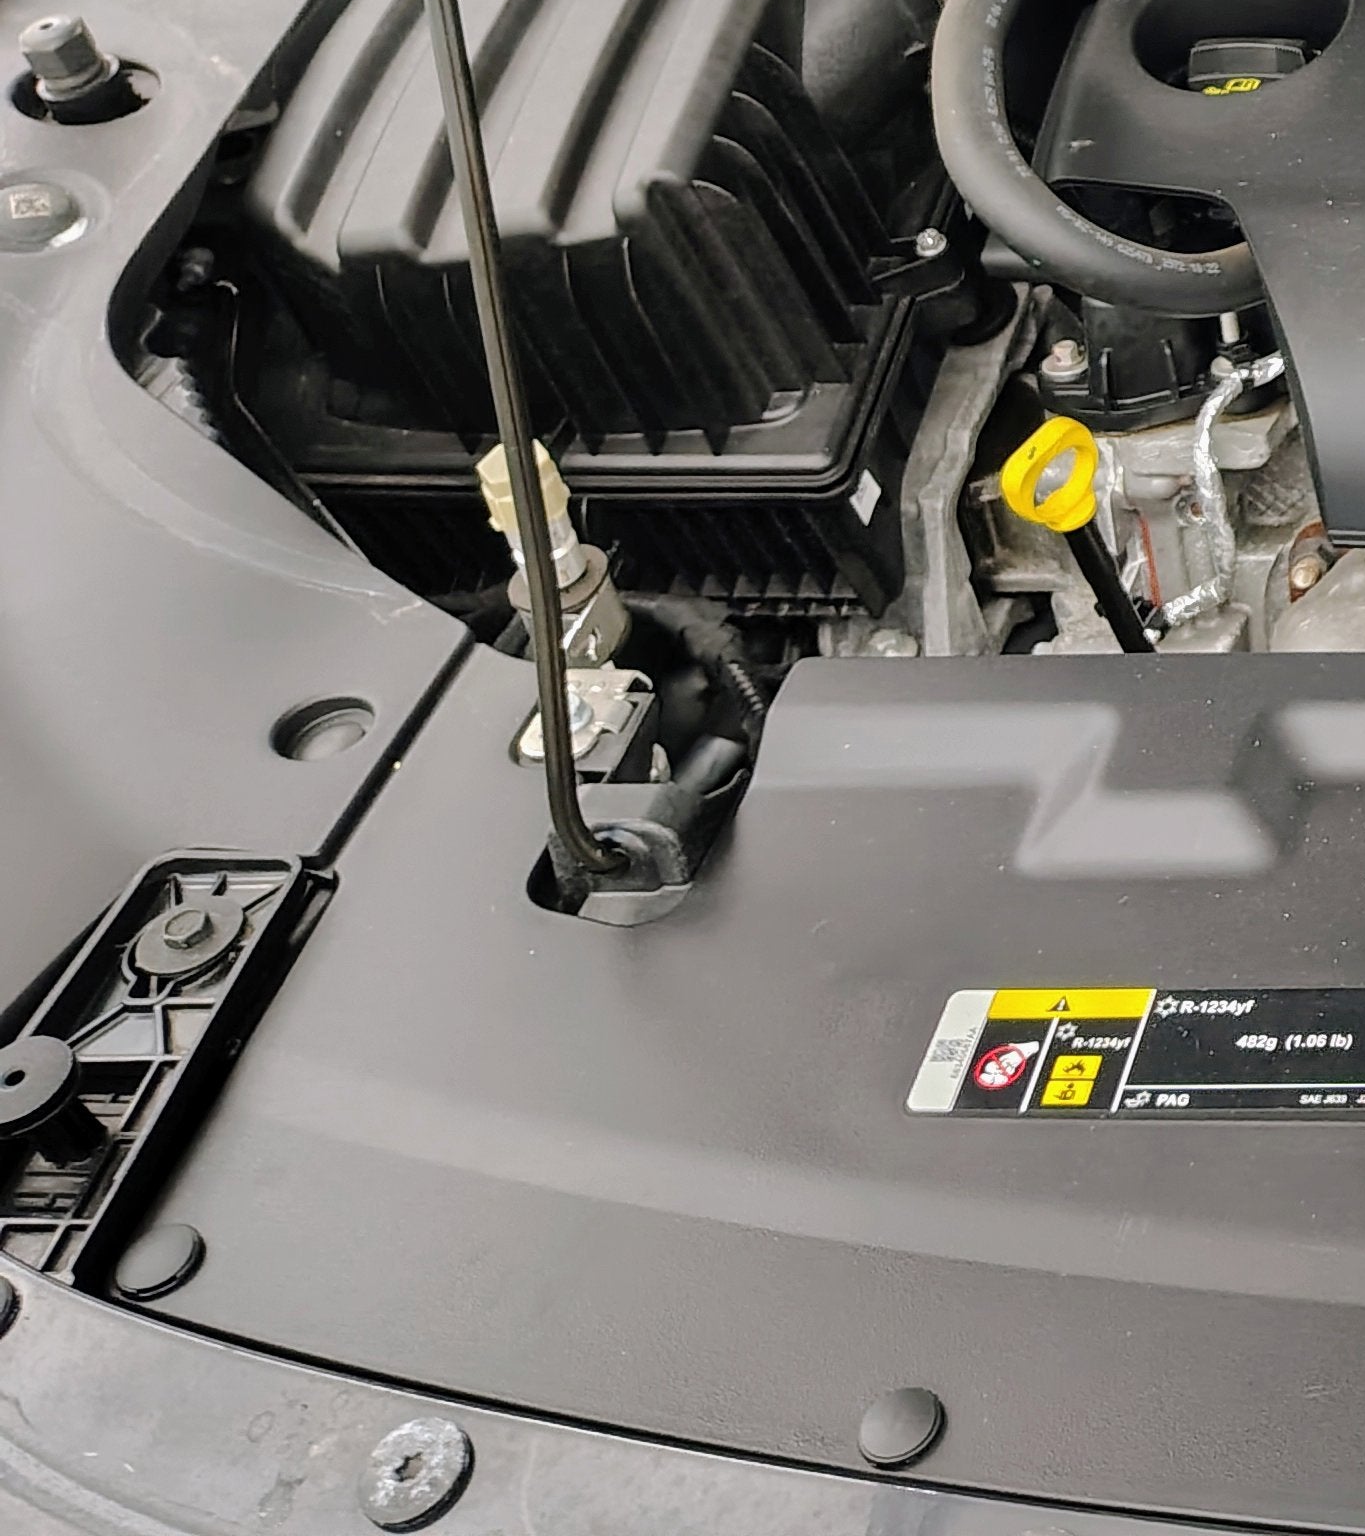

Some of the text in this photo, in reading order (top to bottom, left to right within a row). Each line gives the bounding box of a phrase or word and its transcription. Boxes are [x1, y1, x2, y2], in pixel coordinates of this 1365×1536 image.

[1179, 999, 1256, 1016] R-1234yf
[1071, 1036, 1132, 1051] R-1234yf
[1235, 1033, 1353, 1052] 482g (1.06 lb)
[1155, 1093, 1190, 1107] PAG
[1299, 1094, 1322, 1104] SAE
